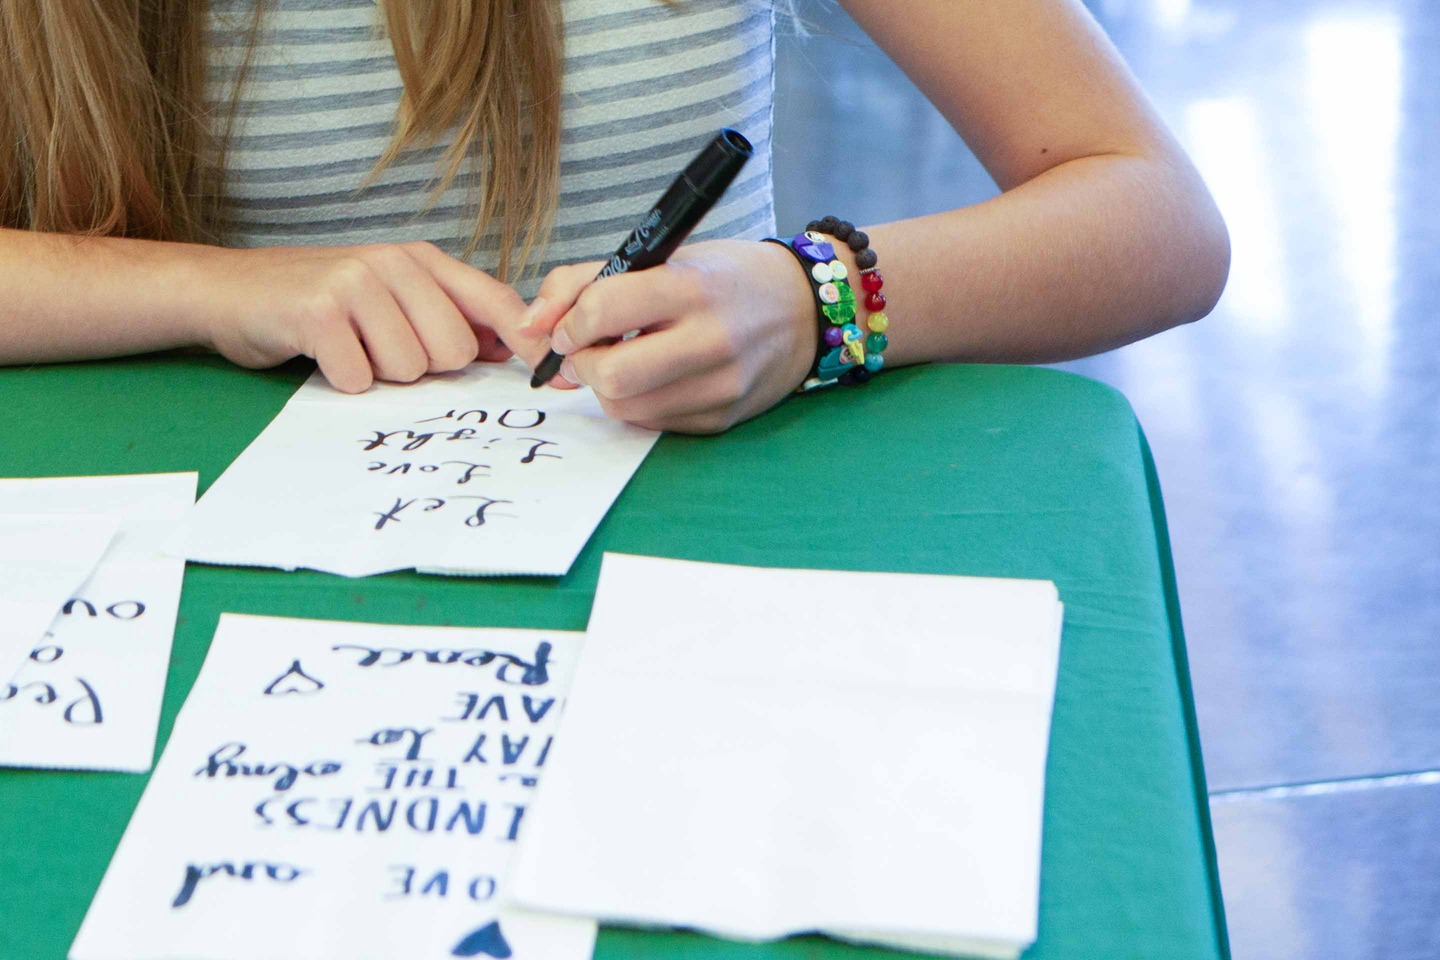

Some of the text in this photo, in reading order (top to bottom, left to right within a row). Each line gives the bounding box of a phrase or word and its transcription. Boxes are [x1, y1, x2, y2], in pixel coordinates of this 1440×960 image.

[414, 408, 546, 428] Our
[358, 428, 563, 464] Light
[367, 461, 491, 484] Love
[374, 495, 516, 530] Let
[440, 692, 558, 724] AVE
[355, 727, 434, 760] to
[366, 762, 465, 791] THE
[254, 796, 528, 842] INDNESS
[171, 862, 498, 909] OVE and
